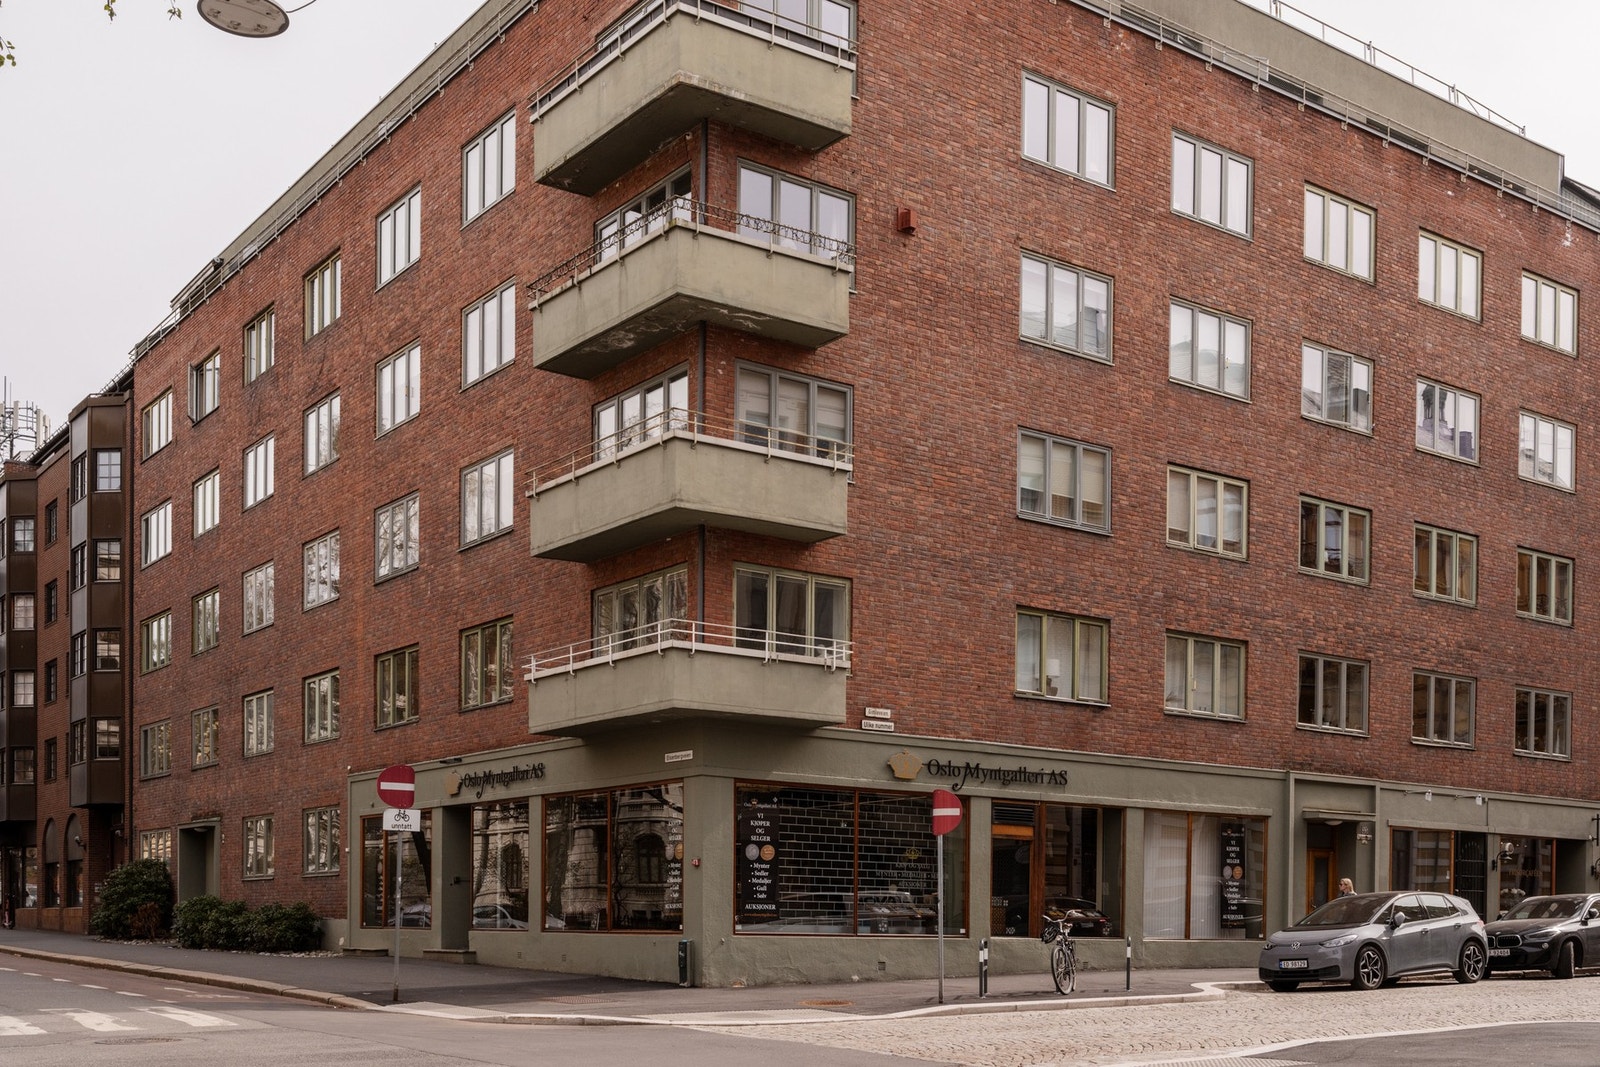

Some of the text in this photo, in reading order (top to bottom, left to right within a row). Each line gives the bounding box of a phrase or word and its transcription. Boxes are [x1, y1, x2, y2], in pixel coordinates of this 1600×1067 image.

[464, 762, 545, 799] Oslo Myntgalleri AS
[926, 758, 1068, 791] Oslo Myntgalleri AS
